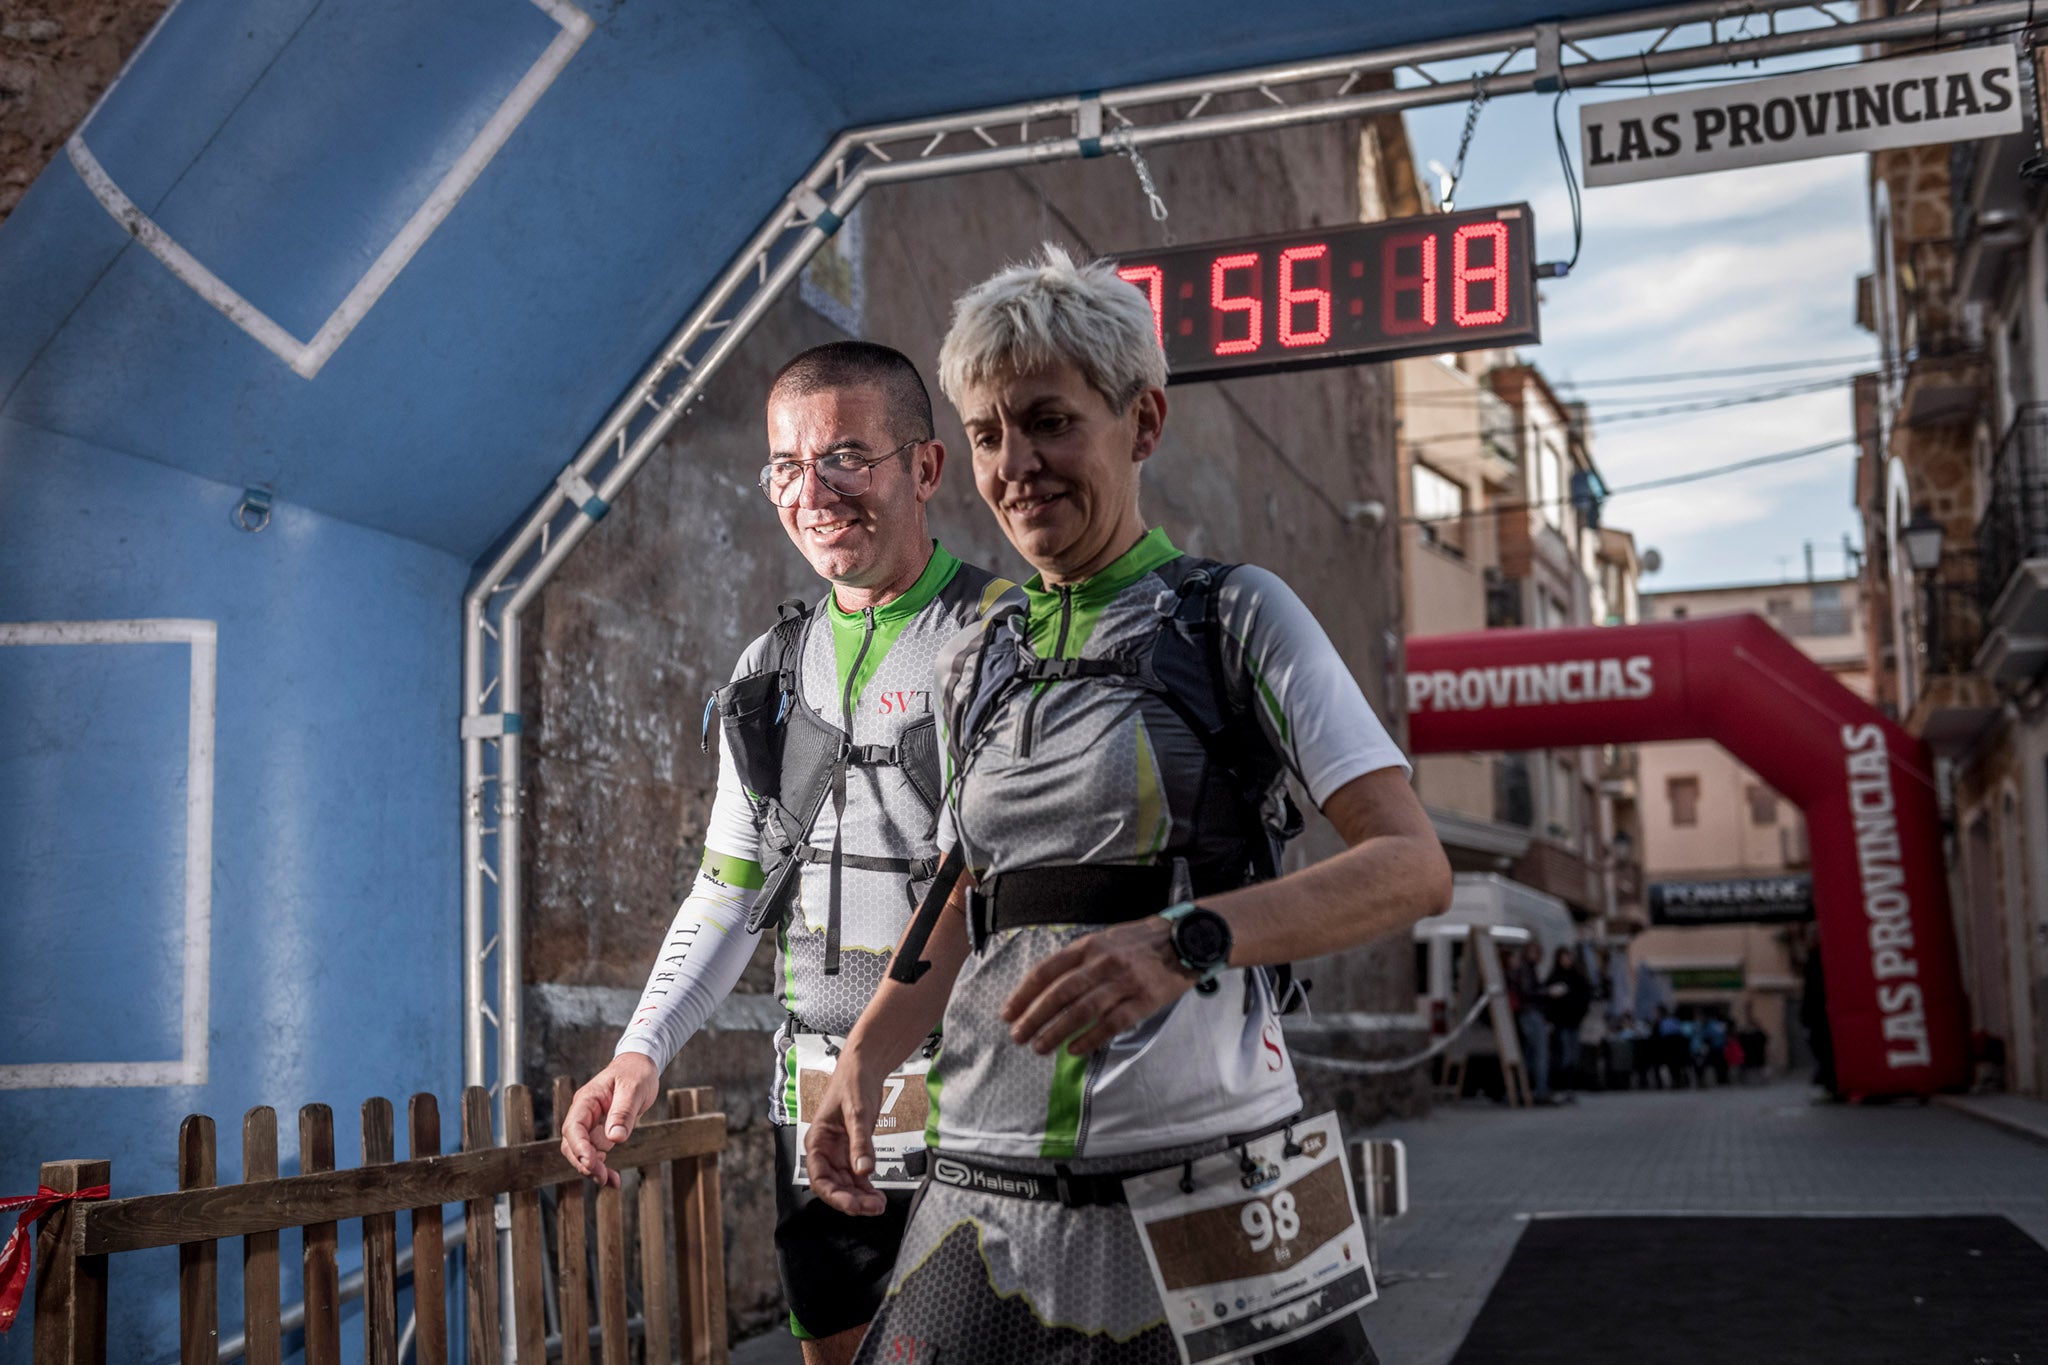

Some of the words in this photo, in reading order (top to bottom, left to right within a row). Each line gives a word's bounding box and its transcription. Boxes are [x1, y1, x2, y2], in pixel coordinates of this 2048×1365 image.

[1588, 113, 1681, 166] LAS
[1694, 67, 2013, 152] PROVINCIAS
[1406, 656, 1654, 713] PROVINCIAS
[1841, 723, 1919, 980] PROVINCIAS
[1878, 982, 1932, 1069] LAS
[972, 1169, 1040, 1200] Kalenji
[1240, 1190, 1301, 1253] 98
